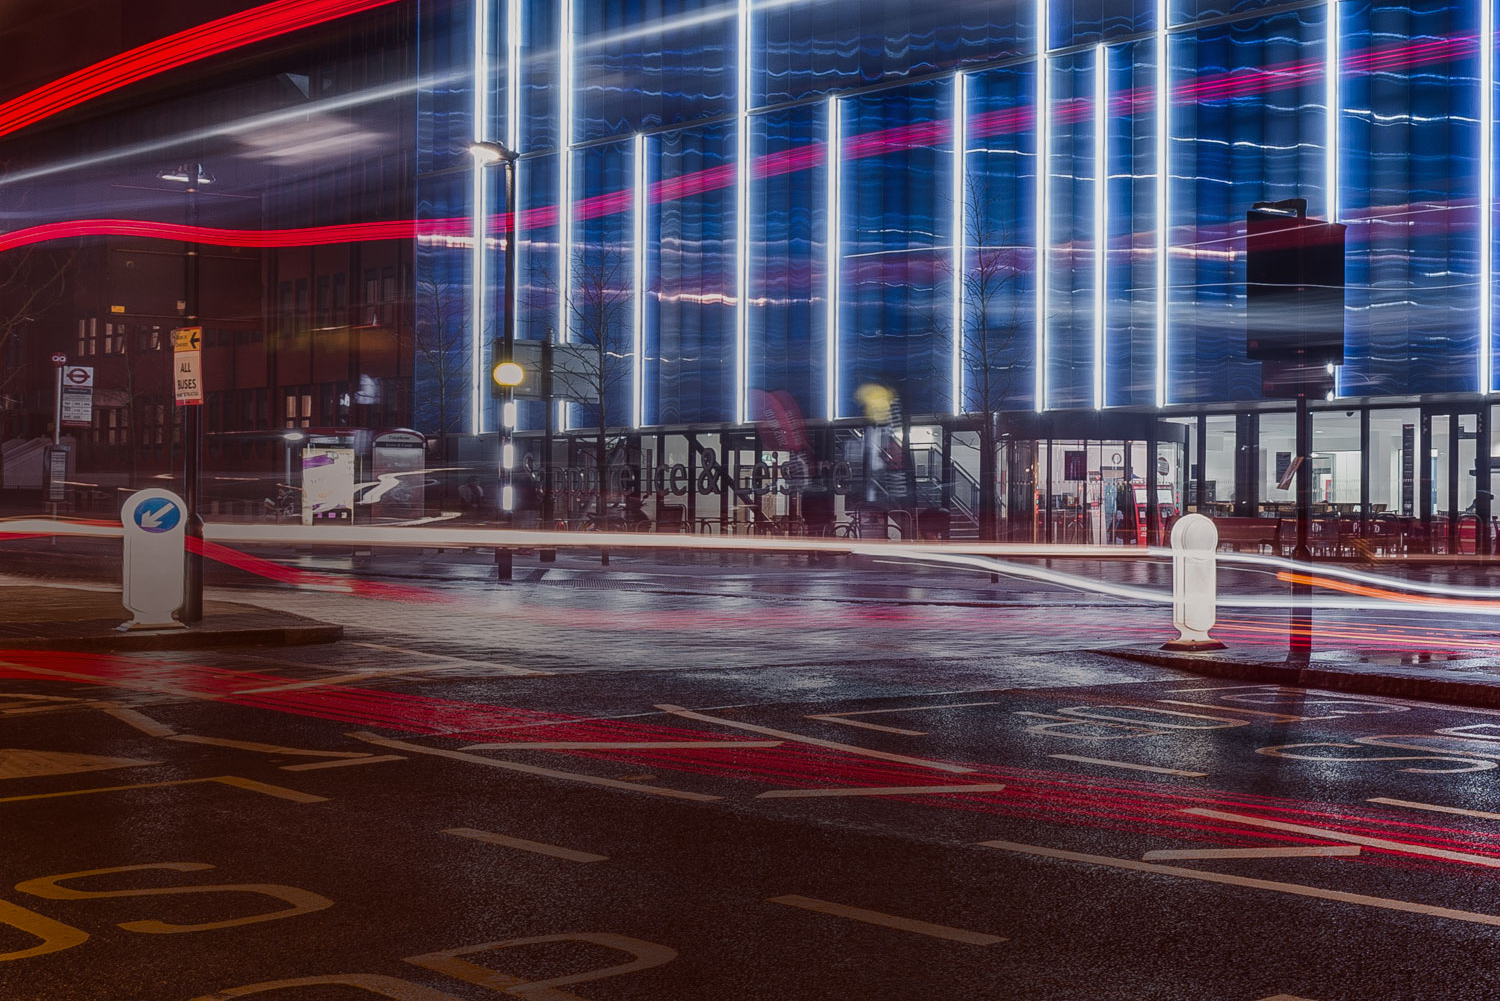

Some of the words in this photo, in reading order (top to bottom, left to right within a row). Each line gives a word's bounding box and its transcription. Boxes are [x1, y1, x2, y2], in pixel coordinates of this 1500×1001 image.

[180, 362, 192, 373] ALL
[177, 379, 197, 390] BUSES
[646, 448, 689, 496] Ice
[697, 447, 722, 496] &
